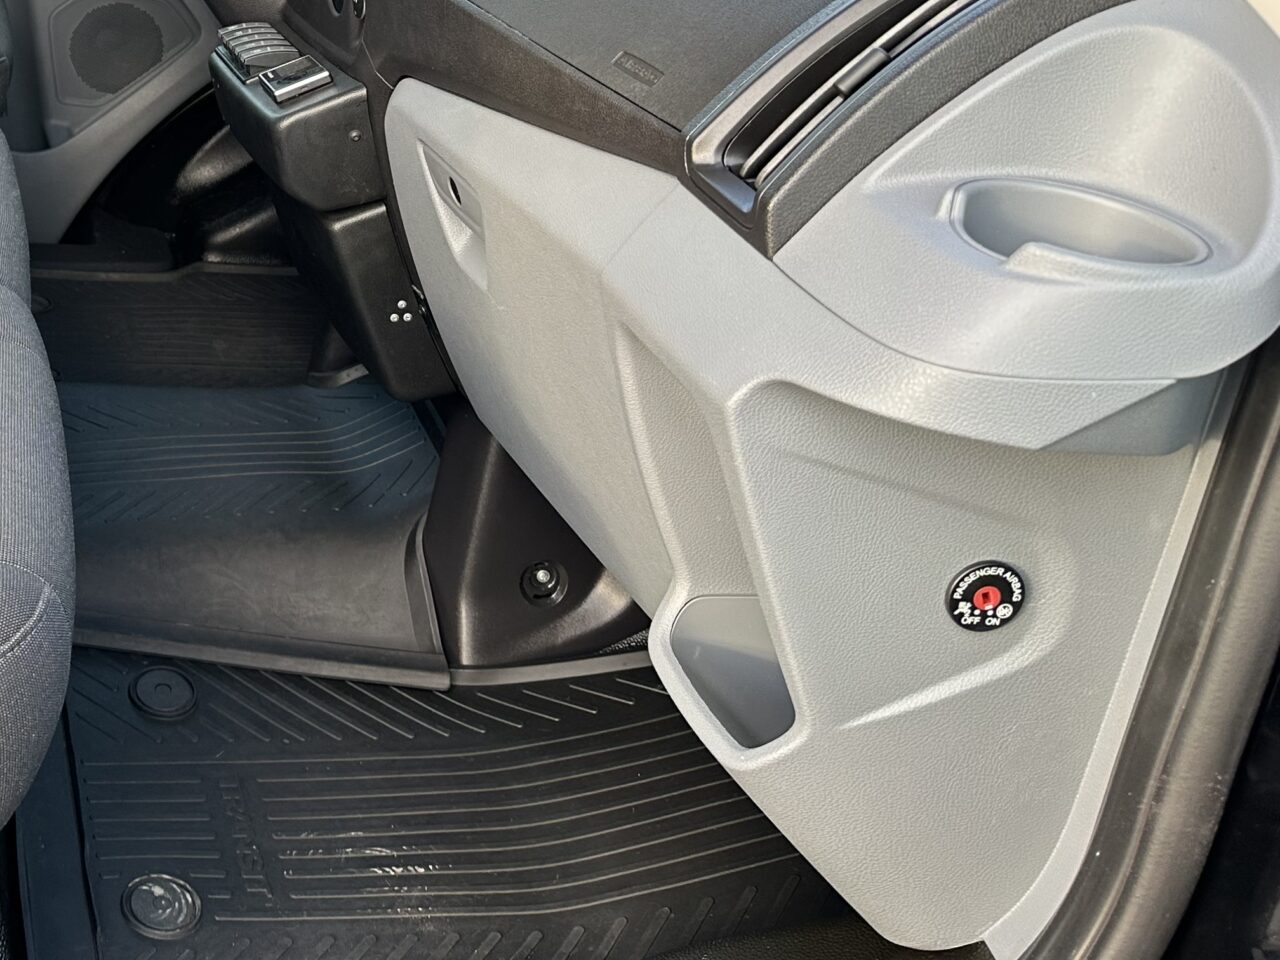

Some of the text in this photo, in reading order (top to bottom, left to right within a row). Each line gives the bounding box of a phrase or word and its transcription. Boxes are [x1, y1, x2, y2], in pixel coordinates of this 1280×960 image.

[953, 566, 1022, 602] PASSENGER AIRBAG
[961, 616, 1000, 626] OFF ON
